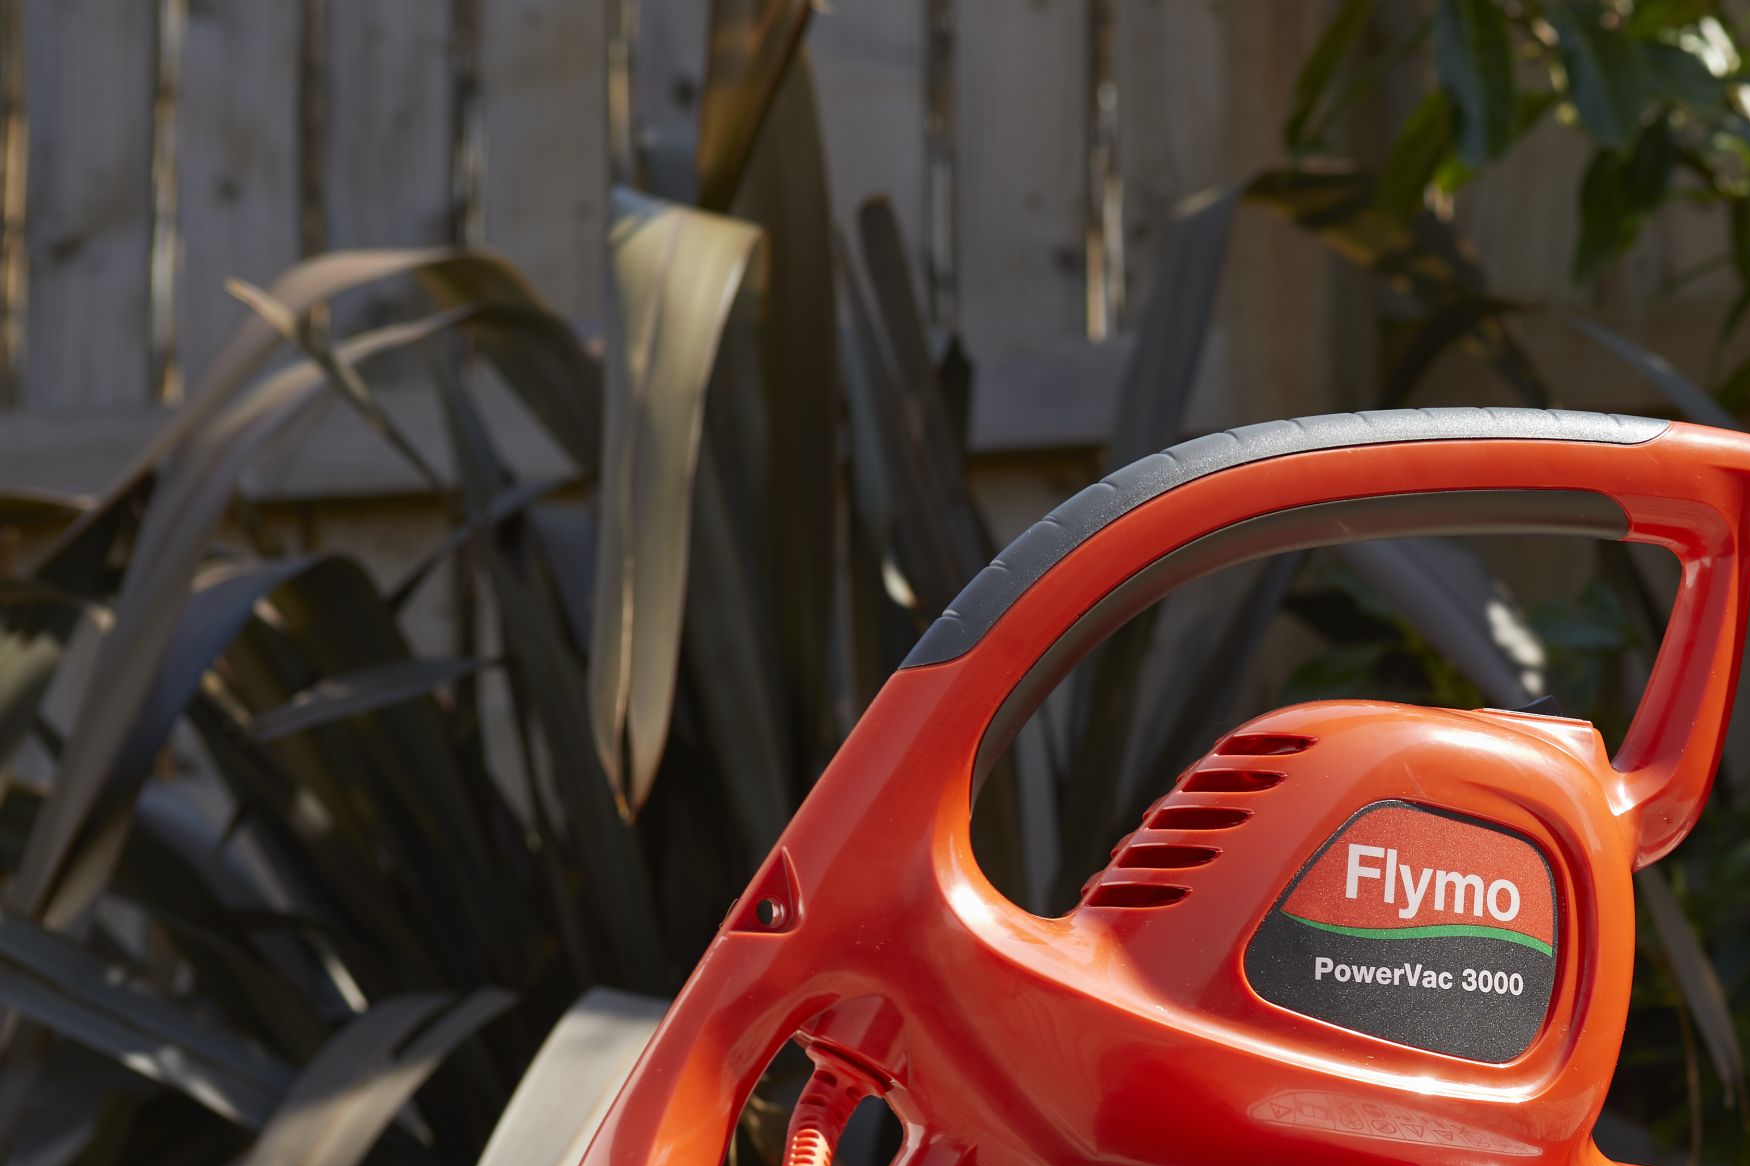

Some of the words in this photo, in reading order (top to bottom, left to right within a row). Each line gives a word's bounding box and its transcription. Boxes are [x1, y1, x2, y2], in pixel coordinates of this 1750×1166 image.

[1345, 843, 1521, 922] Flymo
[1314, 956, 1453, 990] PowerVac
[1461, 968, 1524, 996] 3000
